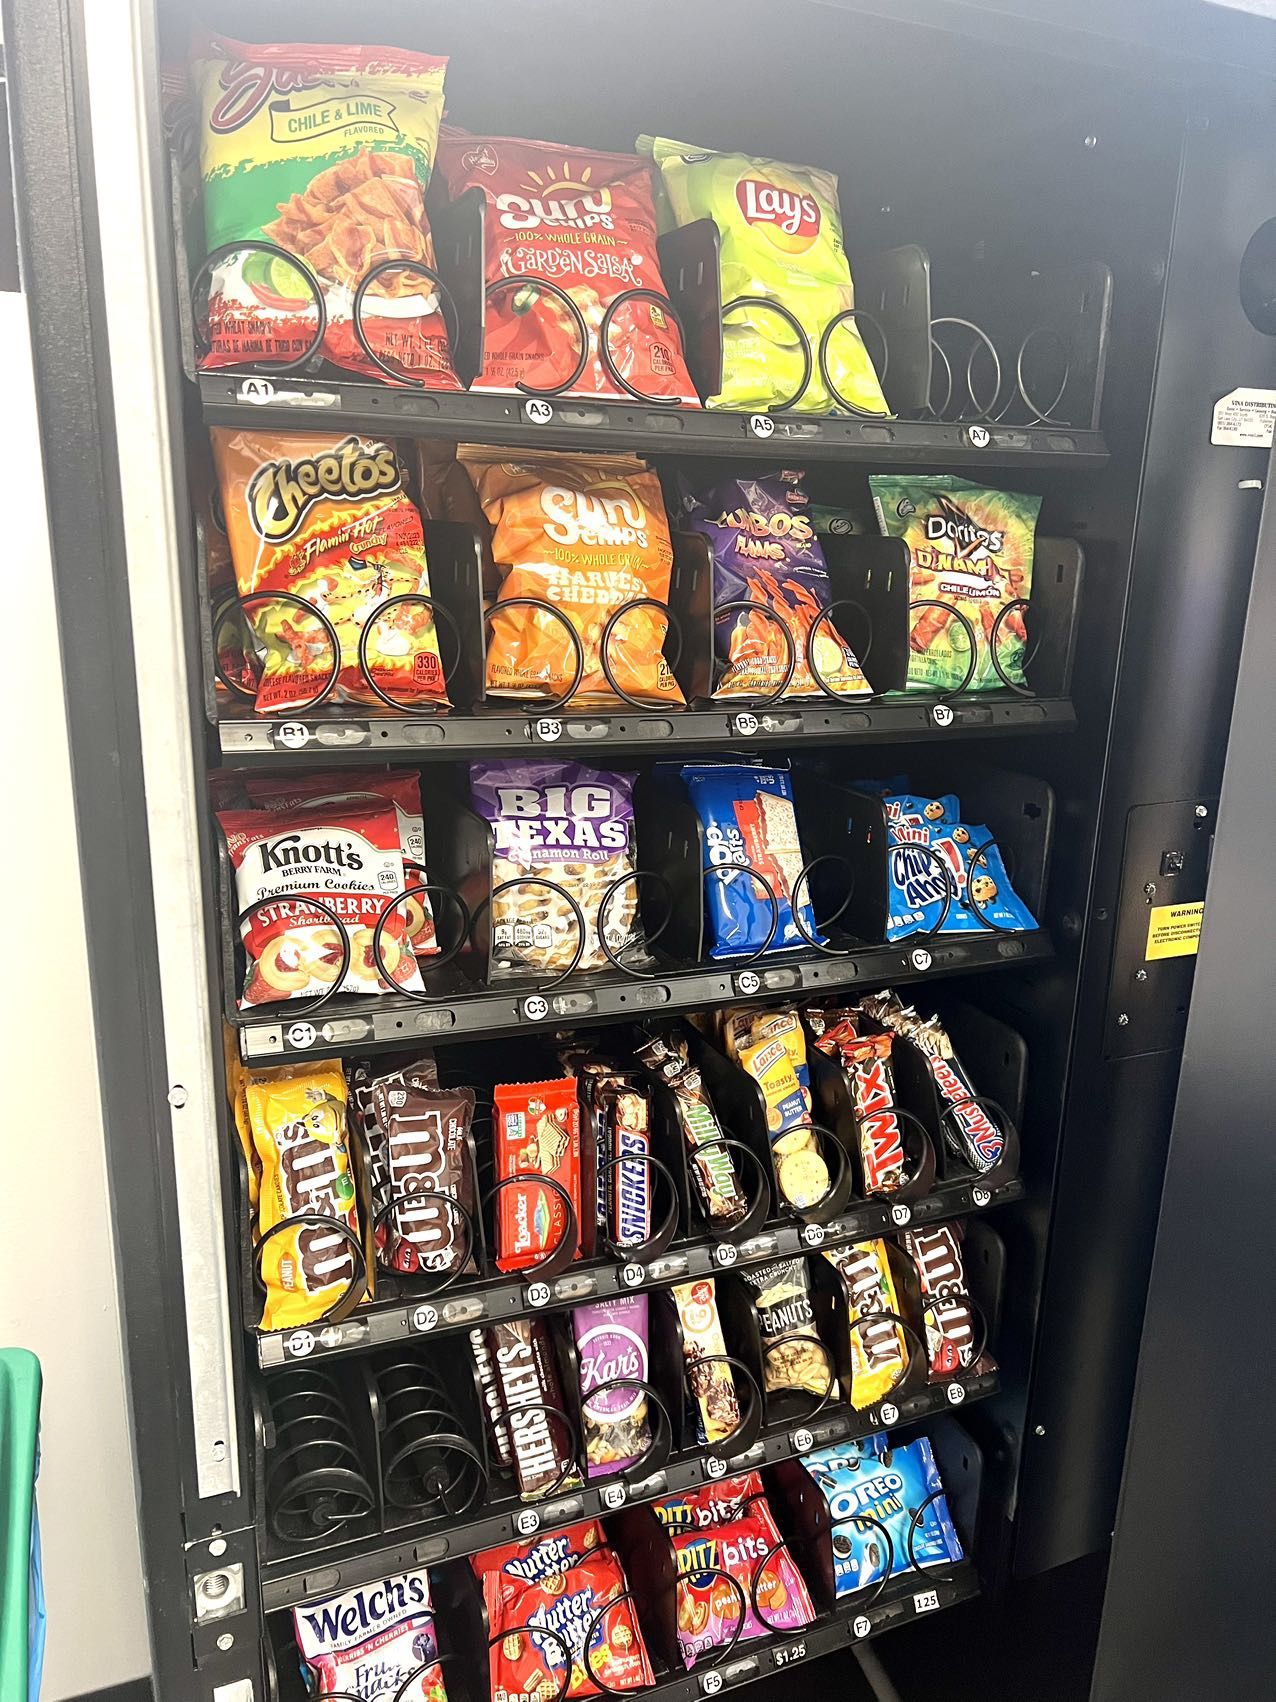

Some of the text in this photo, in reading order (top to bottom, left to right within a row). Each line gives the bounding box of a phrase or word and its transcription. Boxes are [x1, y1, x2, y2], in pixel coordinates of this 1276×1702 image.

[288, 101, 383, 134] CHILE & LIME
[344, 126, 385, 137] FLAVORED
[515, 231, 616, 246] 100% WHOLE GRAIN
[247, 382, 269, 396] A1
[529, 404, 551, 417] A3
[754, 418, 772, 431] A5
[971, 430, 987, 440] A7
[251, 438, 395, 537] Cheetos
[350, 515, 384, 539] Hot
[927, 516, 1004, 551] Doritos
[349, 533, 388, 555] Crunchy
[554, 550, 579, 563] 100%
[581, 553, 616, 566] WHOLE
[939, 583, 969, 595] CHILE
[417, 655, 437, 669] 330
[935, 709, 951, 721] B7
[539, 722, 560, 735] B3
[737, 717, 756, 730] B5
[282, 725, 304, 738] B1
[498, 787, 613, 818] BIG
[491, 819, 628, 849] TEXAS
[258, 834, 363, 875] Knott's
[582, 848, 610, 862] Roll
[281, 864, 342, 878] BERRY FARM
[893, 848, 947, 887] Chips
[380, 873, 394, 881] 240
[257, 878, 376, 901] Premium Cookies
[256, 896, 387, 928] STRAWBERRY
[1170, 907, 1204, 917] WARNING
[289, 913, 360, 928] Shortbead
[914, 953, 929, 964] C7
[741, 976, 758, 988] C5
[527, 1002, 546, 1014] C3
[290, 1028, 312, 1042] C1
[396, 1091, 405, 1106] 230
[782, 1098, 801, 1110] PEANUT
[785, 1106, 803, 1117] BUTTER
[857, 1061, 904, 1188] TWIX
[620, 1133, 646, 1244] SNICKERS
[894, 1209, 909, 1221] D7
[514, 1193, 531, 1253] Loacker
[807, 1228, 822, 1240] D6
[719, 1247, 736, 1260] D5
[281, 1256, 296, 1292] PEANUT
[626, 1268, 643, 1281] D4
[530, 1288, 549, 1301] D3
[620, 1296, 635, 1305] MIX
[417, 1310, 436, 1325] D2
[758, 1299, 813, 1332] PEANUTS
[949, 1387, 963, 1399] E8
[496, 1340, 557, 1477] HERSHEY'S
[883, 1408, 896, 1420] E7
[796, 1434, 812, 1447] E6
[710, 1461, 726, 1473] E5
[607, 1490, 624, 1503] E4
[830, 1474, 903, 1520] OREO
[520, 1513, 538, 1529] E3
[677, 1536, 769, 1584] RITZ bits
[302, 1575, 425, 1644] Welch's
[331, 1609, 407, 1649] FAMILY FARMER OWNED
[856, 1620, 869, 1633] F7
[375, 1623, 410, 1648] CHERRIES
[775, 1645, 806, 1666] $1.25
[705, 1678, 721, 1690] F5
